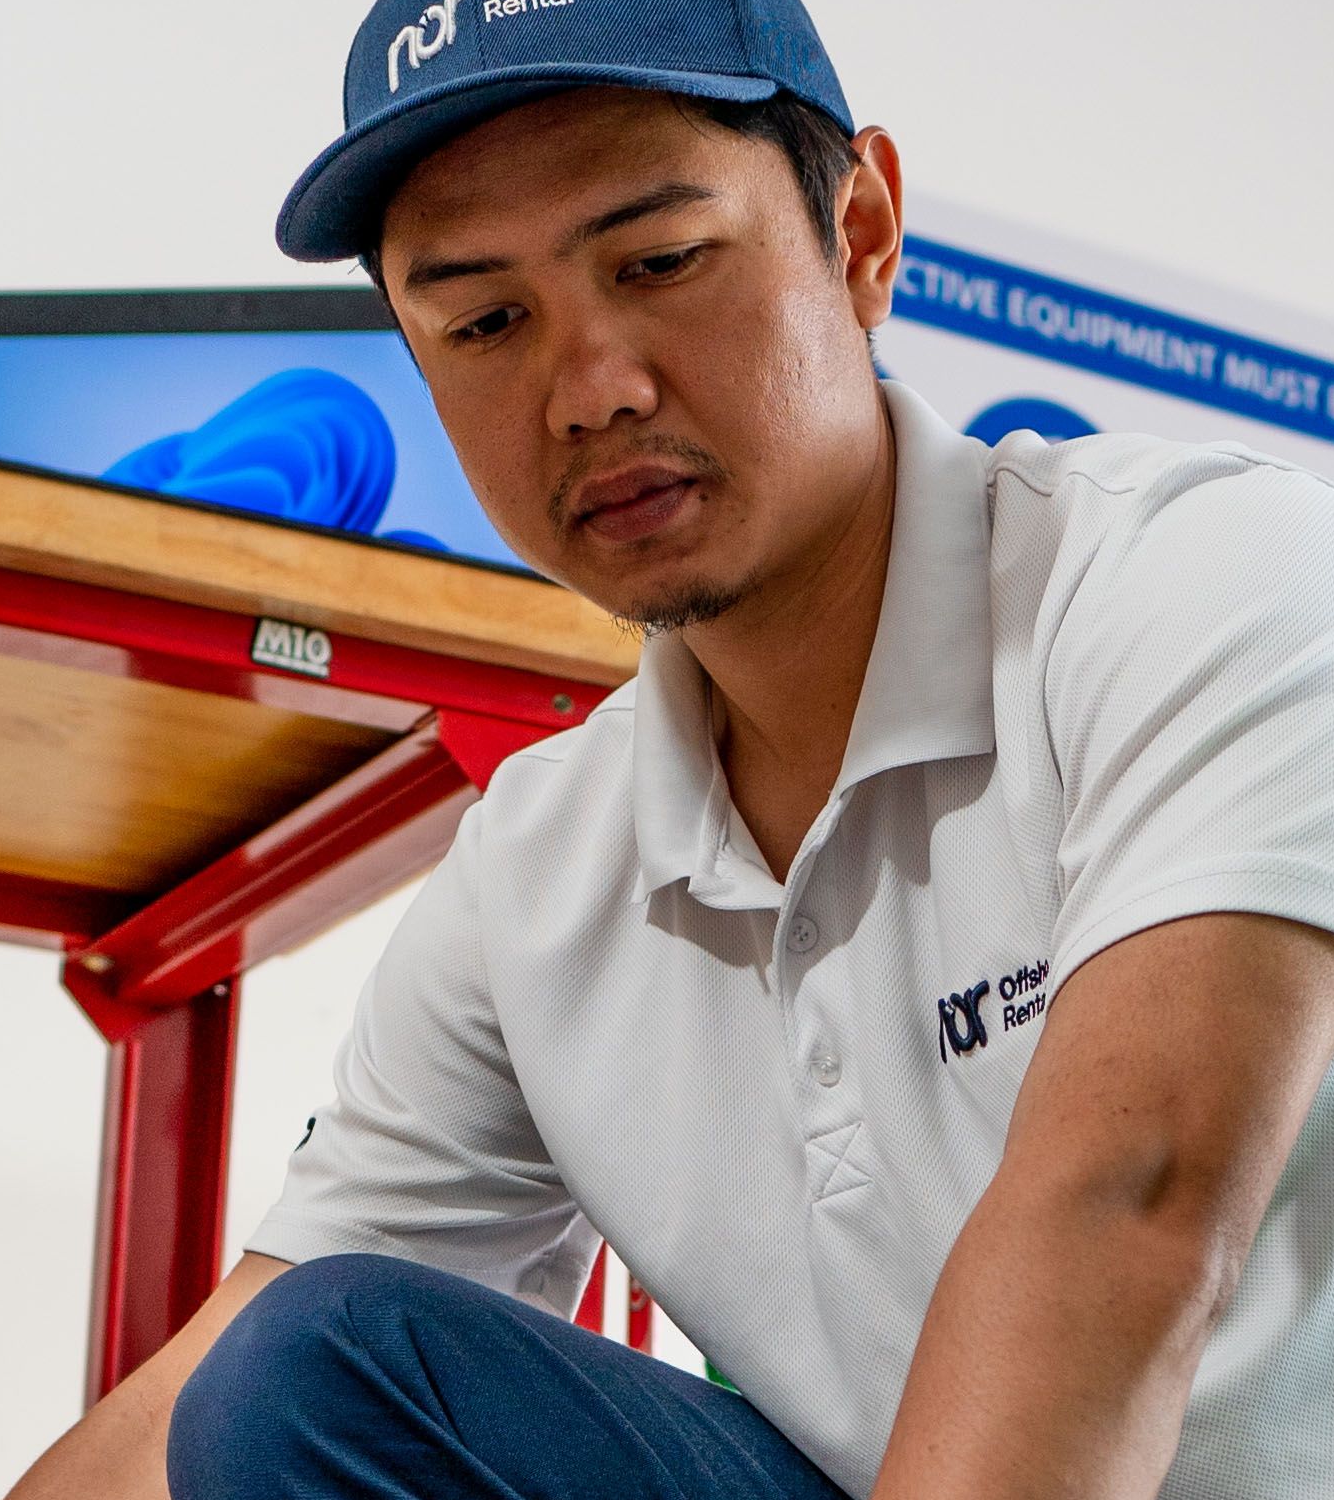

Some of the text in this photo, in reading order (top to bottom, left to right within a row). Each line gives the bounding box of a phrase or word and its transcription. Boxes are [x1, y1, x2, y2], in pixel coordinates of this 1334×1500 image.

[895, 254, 1003, 320] CTIVE
[1006, 286, 1220, 382] EQUIPMENT
[1222, 350, 1322, 412] MUST
